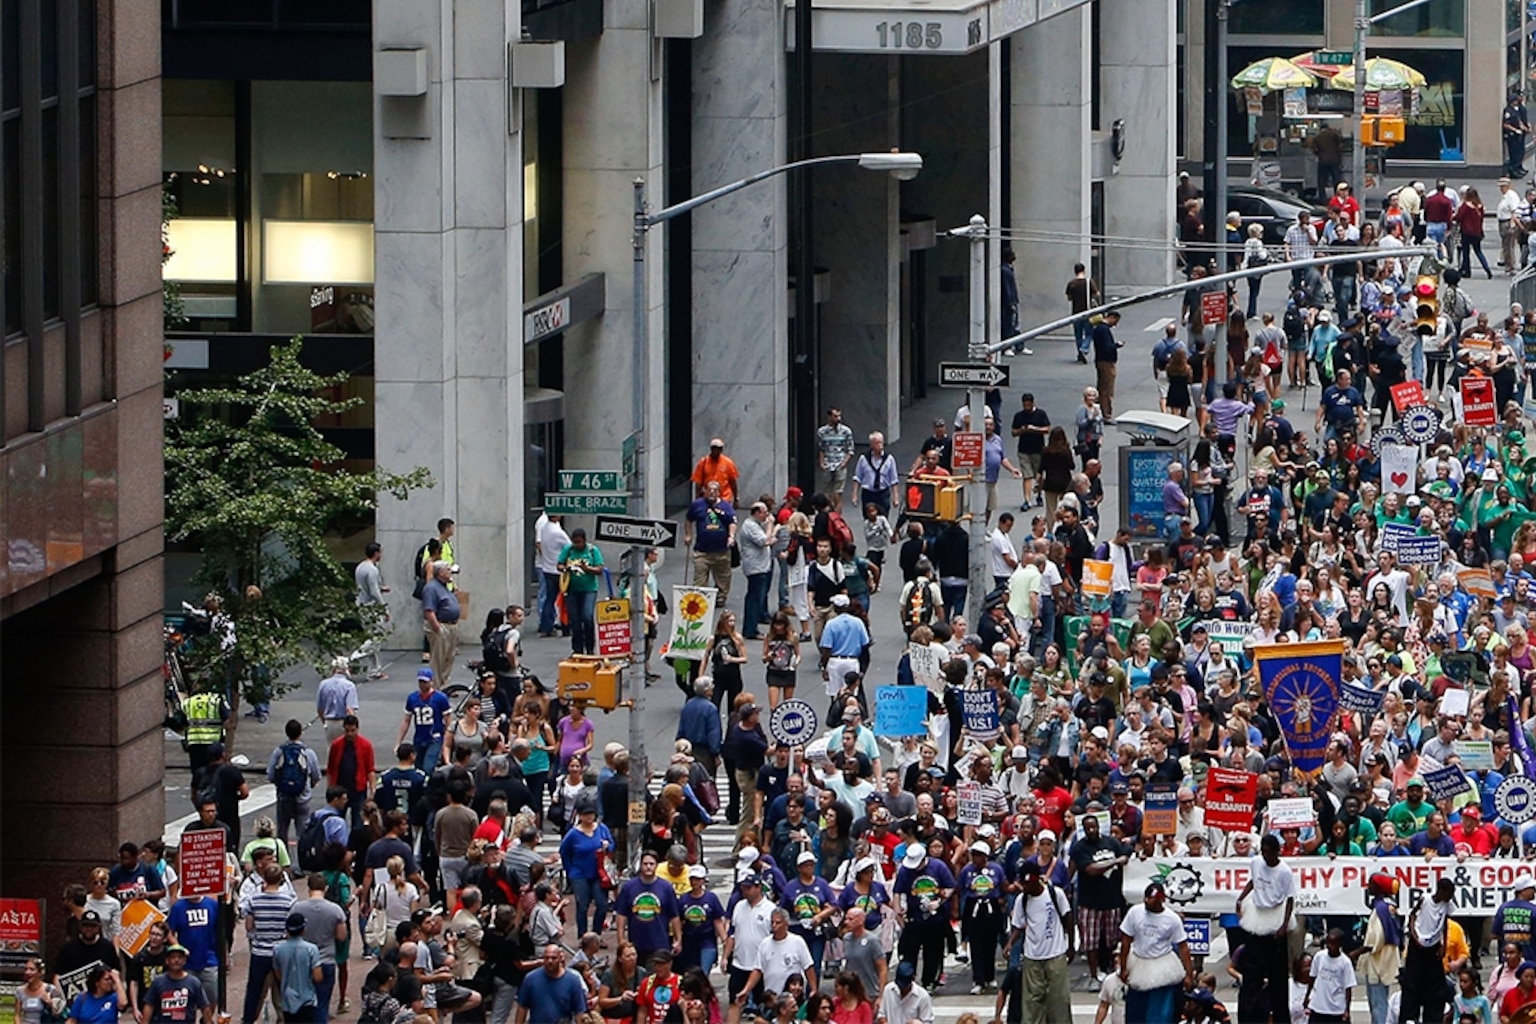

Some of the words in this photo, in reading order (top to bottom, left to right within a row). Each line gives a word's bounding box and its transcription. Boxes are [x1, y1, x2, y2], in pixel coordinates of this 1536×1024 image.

[876, 22, 943, 48] 1185
[950, 370, 970, 380] ONE
[979, 370, 999, 381] WAY
[562, 476, 571, 489] W
[580, 475, 601, 489] 46
[545, 496, 582, 508] LITTLE
[585, 496, 624, 508] BRAZIL
[606, 524, 630, 536] ONE
[640, 526, 664, 541] WAY
[963, 691, 996, 704] DON'T
[414, 706, 434, 726] 12
[963, 703, 996, 716] FRACK
[781, 716, 804, 729] UAW
[1205, 799, 1254, 814] SOLIDARITY
[1506, 792, 1528, 809] UAW
[1214, 867, 1330, 890] HEHY
[1343, 866, 1445, 889] PLNET
[1454, 866, 1471, 886] &
